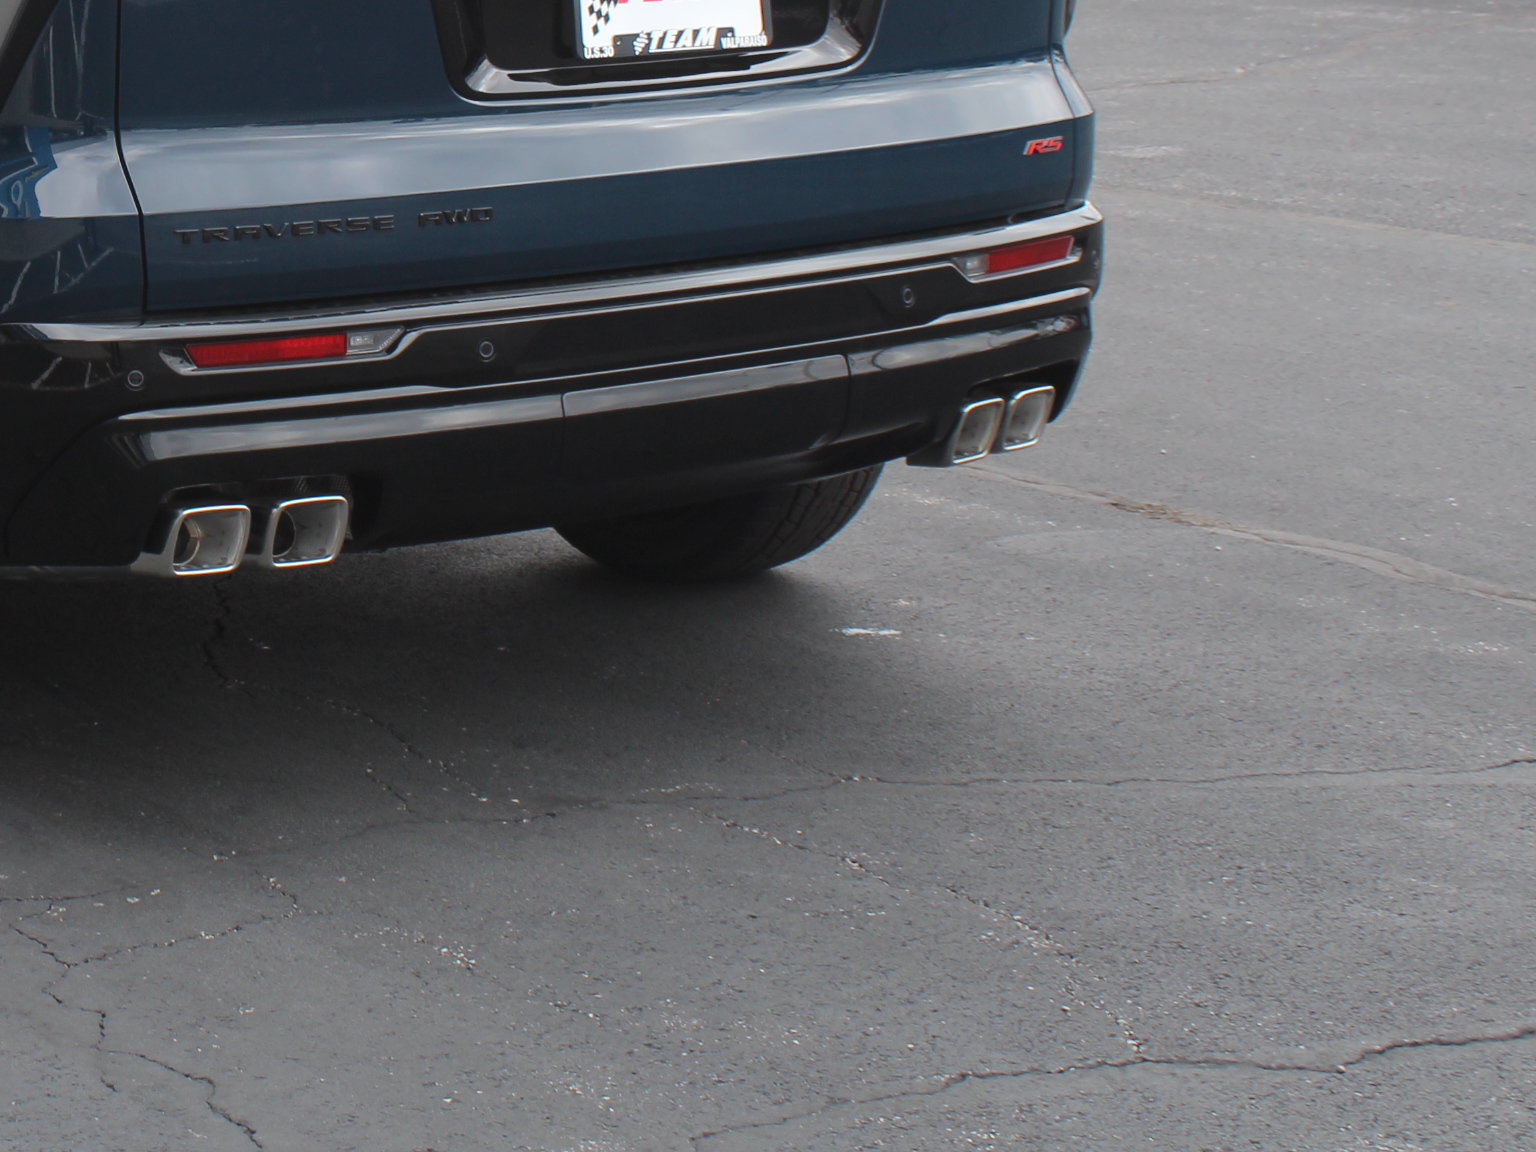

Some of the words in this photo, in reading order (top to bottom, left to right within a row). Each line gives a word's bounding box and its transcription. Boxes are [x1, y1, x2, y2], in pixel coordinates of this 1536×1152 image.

[648, 28, 716, 52] TEAM
[1023, 136, 1064, 155] RS
[175, 214, 395, 244] TRAVERSE
[418, 206, 494, 228] AWD
